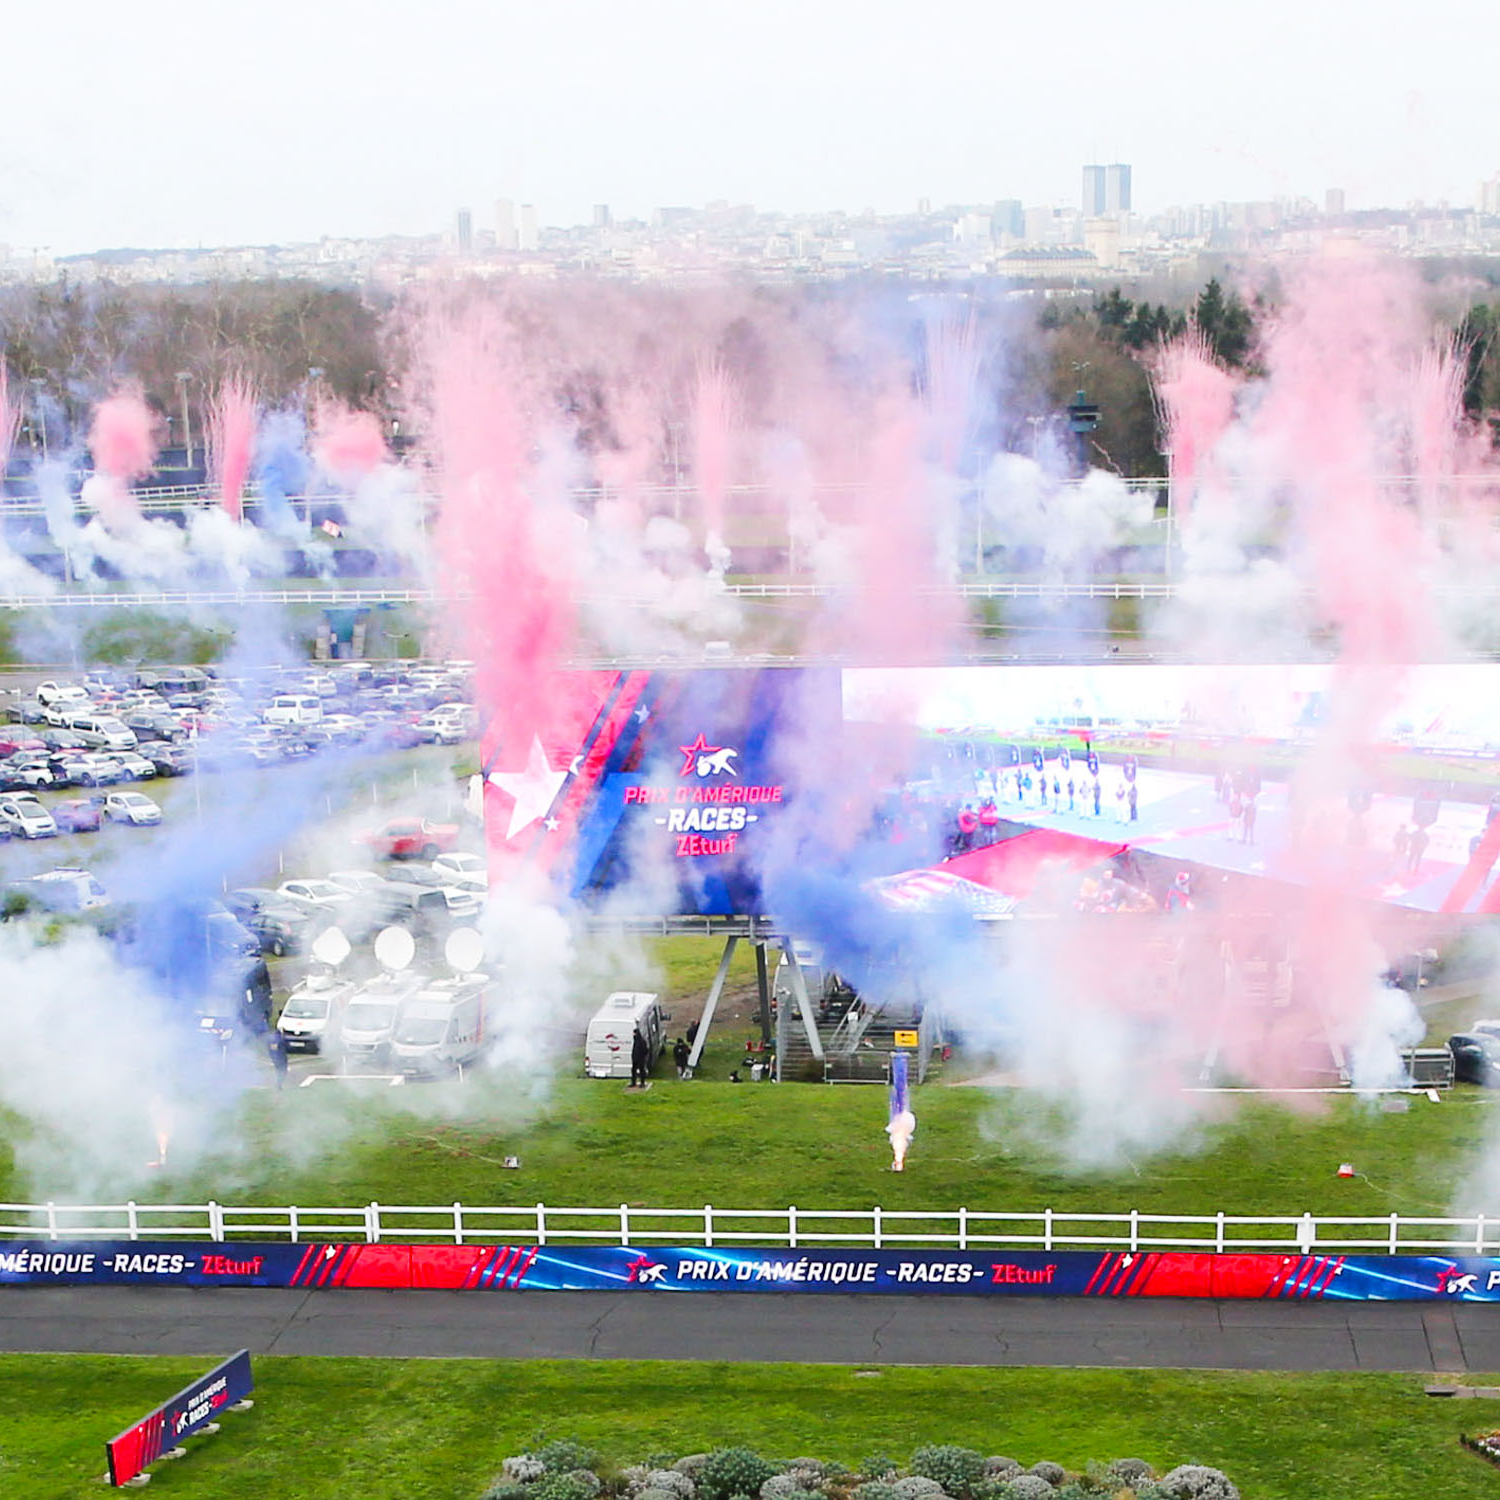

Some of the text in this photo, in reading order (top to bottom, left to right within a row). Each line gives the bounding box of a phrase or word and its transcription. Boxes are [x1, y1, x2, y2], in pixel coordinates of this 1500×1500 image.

[623, 782, 784, 805] PRIX D'AMÉRIQUE
[676, 834, 738, 857] ZEturf
[201, 1254, 265, 1275] ZEturf
[677, 1261, 730, 1280] PRIX
[737, 1257, 878, 1284] D'AMÉRIQUE
[991, 1264, 1056, 1284] ZEturf
